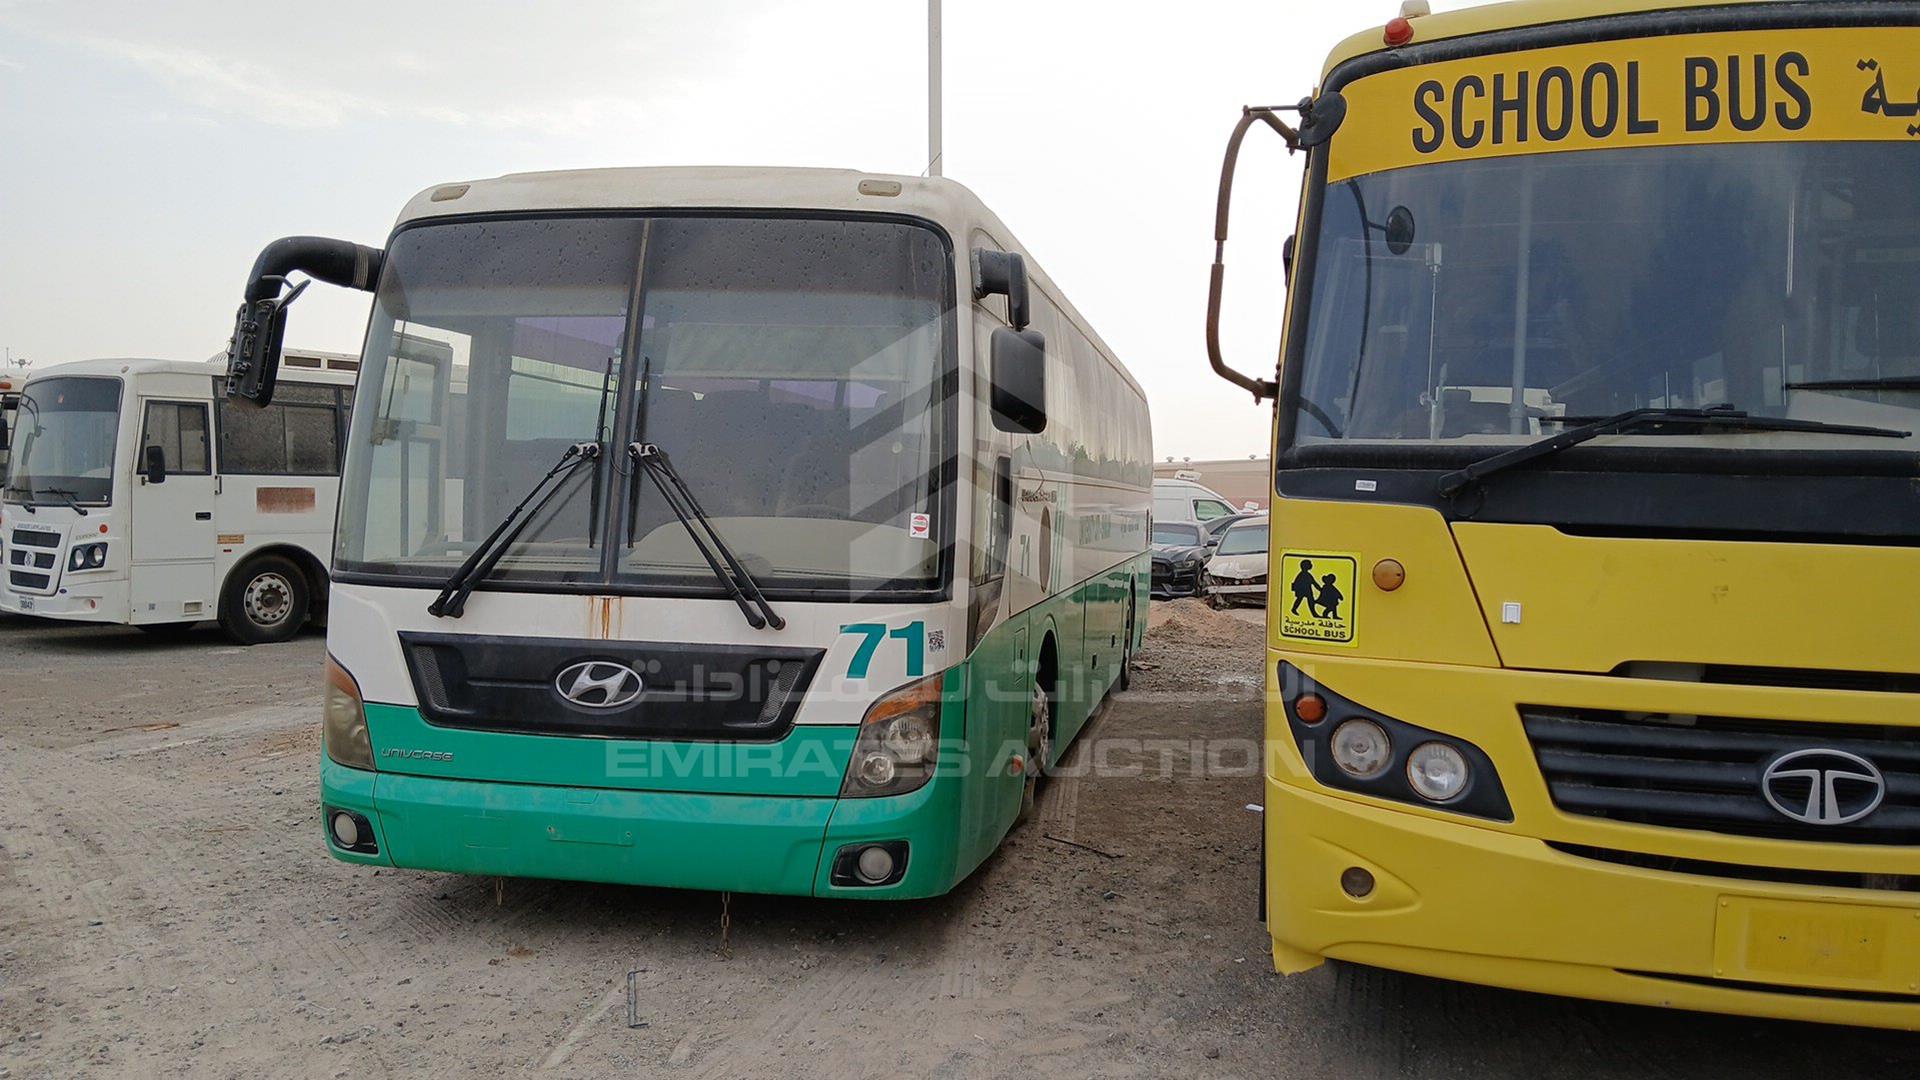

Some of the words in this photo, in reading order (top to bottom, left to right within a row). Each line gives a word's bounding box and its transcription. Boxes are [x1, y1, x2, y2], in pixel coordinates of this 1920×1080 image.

[1412, 61, 1660, 154] SCHOOL
[1685, 51, 1812, 132] BUS
[840, 621, 924, 679] 71
[1284, 625, 1321, 637] SCHOOL
[1323, 629, 1347, 639] BUS
